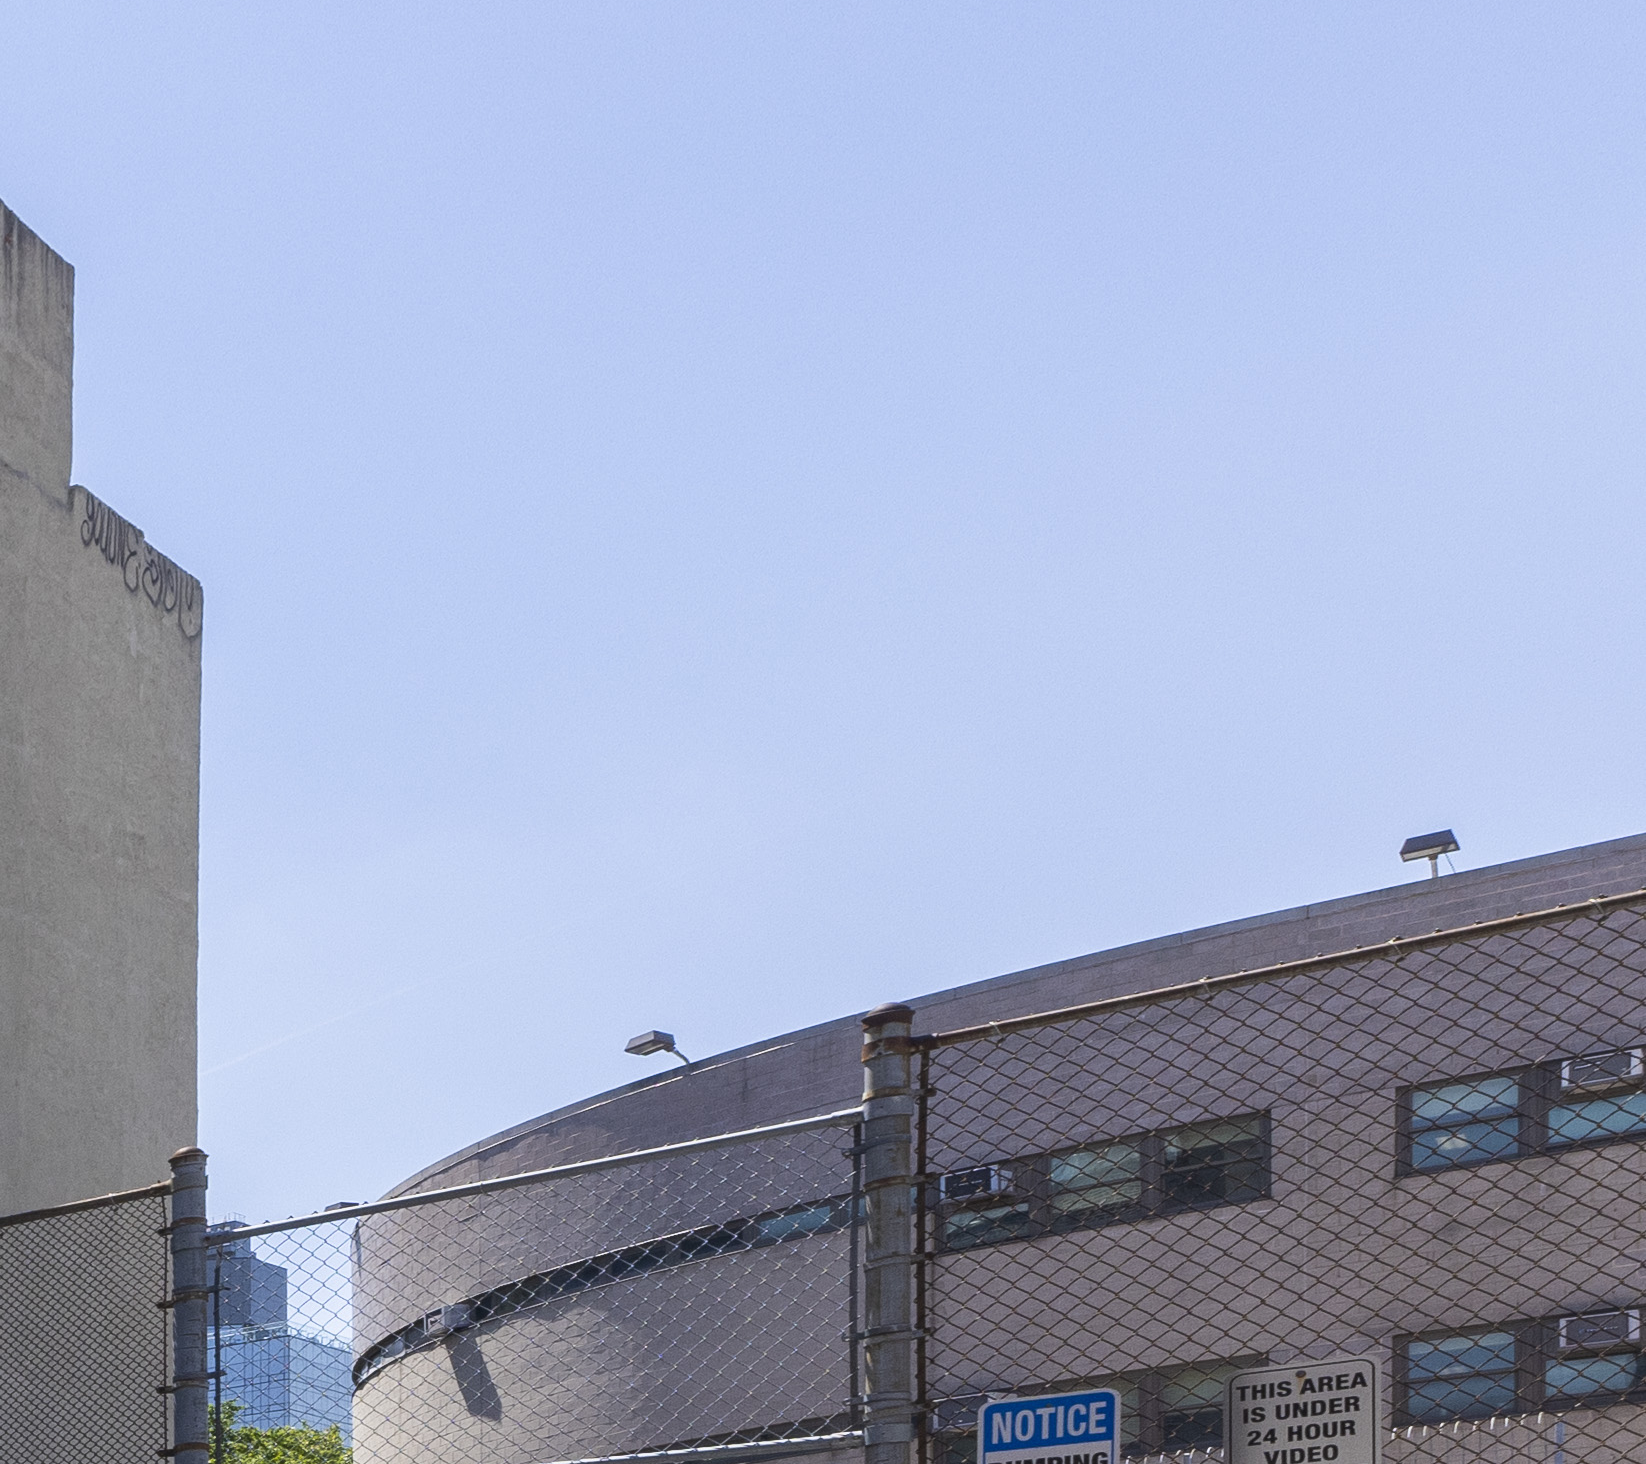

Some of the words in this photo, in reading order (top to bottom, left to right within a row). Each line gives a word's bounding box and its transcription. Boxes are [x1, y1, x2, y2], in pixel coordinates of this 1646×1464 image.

[1236, 1379, 1293, 1402] THIS
[1299, 1371, 1368, 1395] AREA
[990, 1400, 1107, 1444] NOTICE
[1242, 1404, 1265, 1425] IS
[1275, 1394, 1361, 1421] UNDER
[1247, 1429, 1279, 1447] 24
[1287, 1419, 1357, 1443] HOUR
